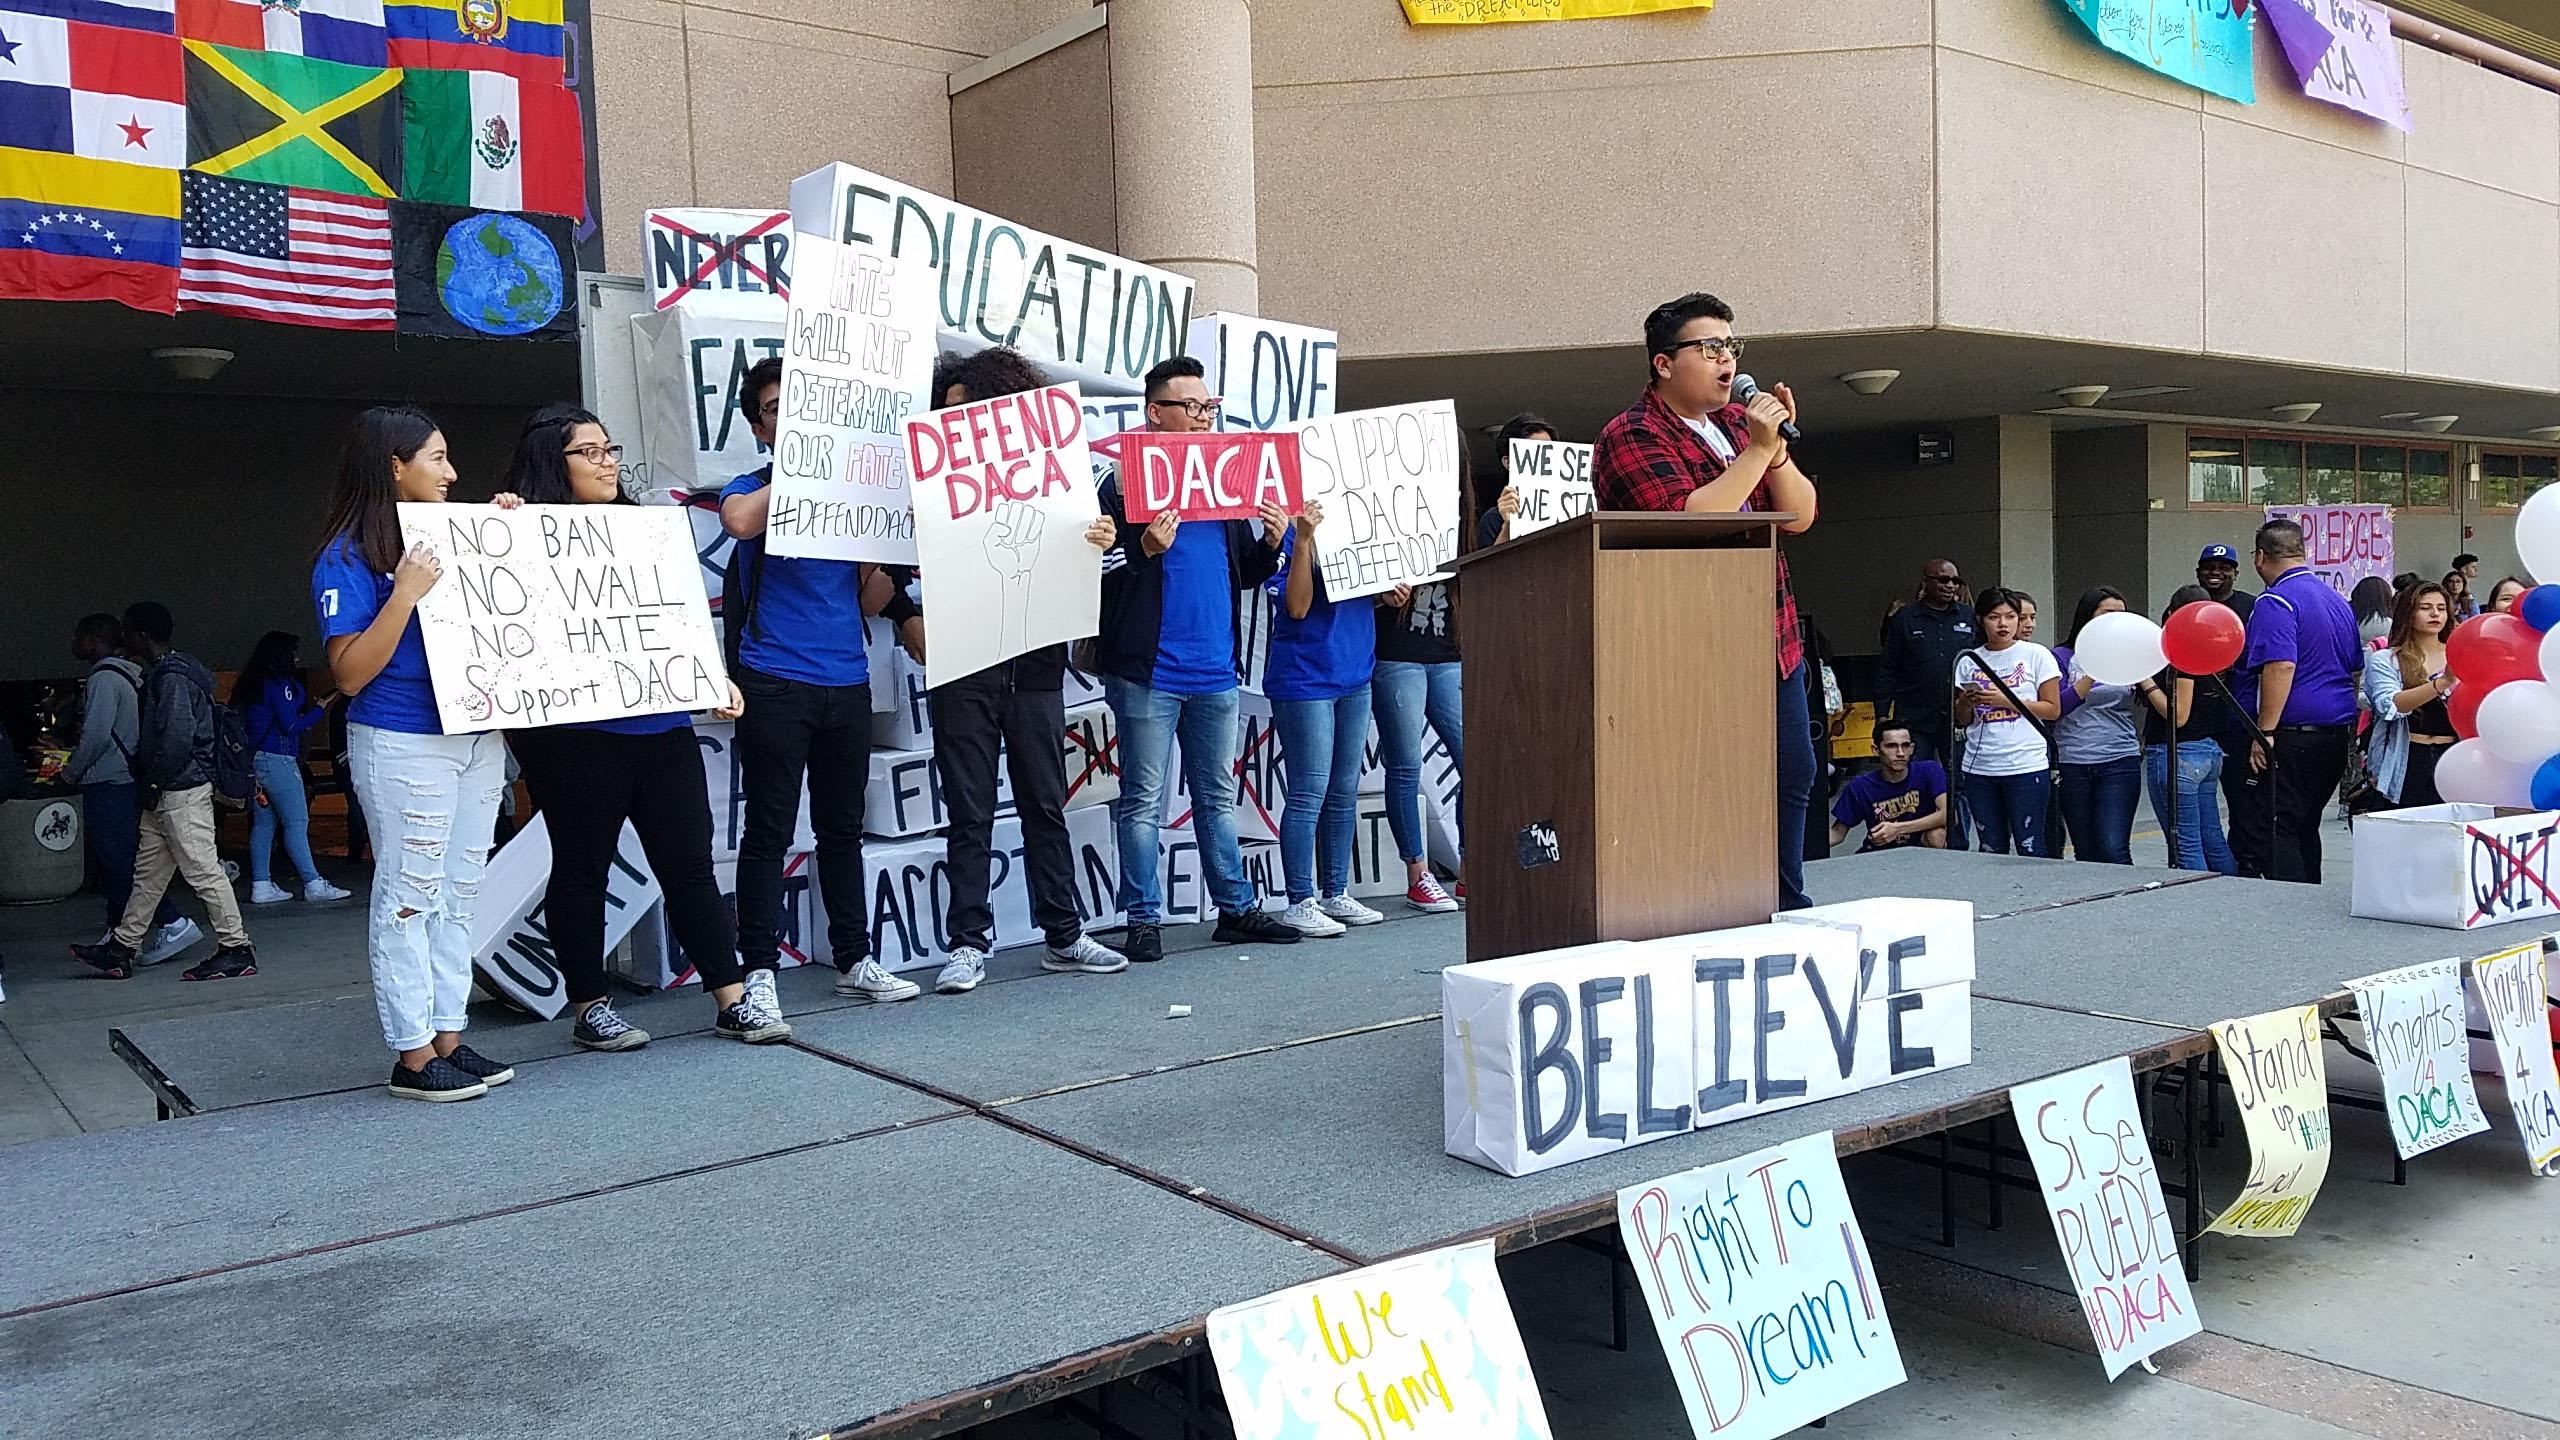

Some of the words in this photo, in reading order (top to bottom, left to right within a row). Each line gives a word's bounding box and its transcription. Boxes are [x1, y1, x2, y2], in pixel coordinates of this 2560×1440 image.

[1429, 2, 1455, 15] the
[651, 229, 791, 295] NEVER
[829, 249, 896, 318] HATE
[843, 183, 1193, 379] EDUCATION
[792, 307, 851, 365] WILL
[862, 321, 912, 379] NOT
[1216, 322, 1338, 432] LOVE
[786, 368, 912, 437] DETERMINE
[906, 386, 1082, 482] DEFEND
[780, 430, 835, 481] OUR
[846, 441, 905, 490] FATE
[944, 449, 1072, 521] DACA
[1142, 438, 1289, 511] DACA
[1301, 408, 1451, 495] SUPPORT
[1512, 442, 1554, 476] WE
[1559, 446, 1593, 482] SE
[448, 516, 513, 558] NO
[540, 514, 615, 558] BAN
[1341, 484, 1437, 545] DACA
[1515, 485, 1551, 522] WE
[2301, 510, 2383, 565] PLEDGE
[457, 563, 528, 618] NO
[549, 563, 686, 611] WALL
[471, 622, 535, 658] NO
[563, 613, 671, 654] HATE
[284, 685, 293, 701] 6
[465, 664, 601, 724] Support
[614, 655, 720, 708] DACA
[2470, 826, 2559, 919] QUIT
[2478, 950, 2545, 1047] Knights
[1517, 934, 1936, 1155] BELIEVE
[2226, 1016, 2317, 1110] Stand
[2364, 989, 2456, 1096] Knights
[2424, 1059, 2436, 1087] 4
[2515, 1046, 2531, 1095] 4
[2083, 1084, 2144, 1177] Se
[2397, 1081, 2463, 1143] DACA
[1630, 1172, 1760, 1321] Right
[1747, 1157, 1813, 1266] To
[2056, 1167, 2179, 1291] PUEDE
[1312, 1289, 1409, 1366] We
[1680, 1221, 1879, 1434] Dream!
[2082, 1272, 2184, 1355] #DACA
